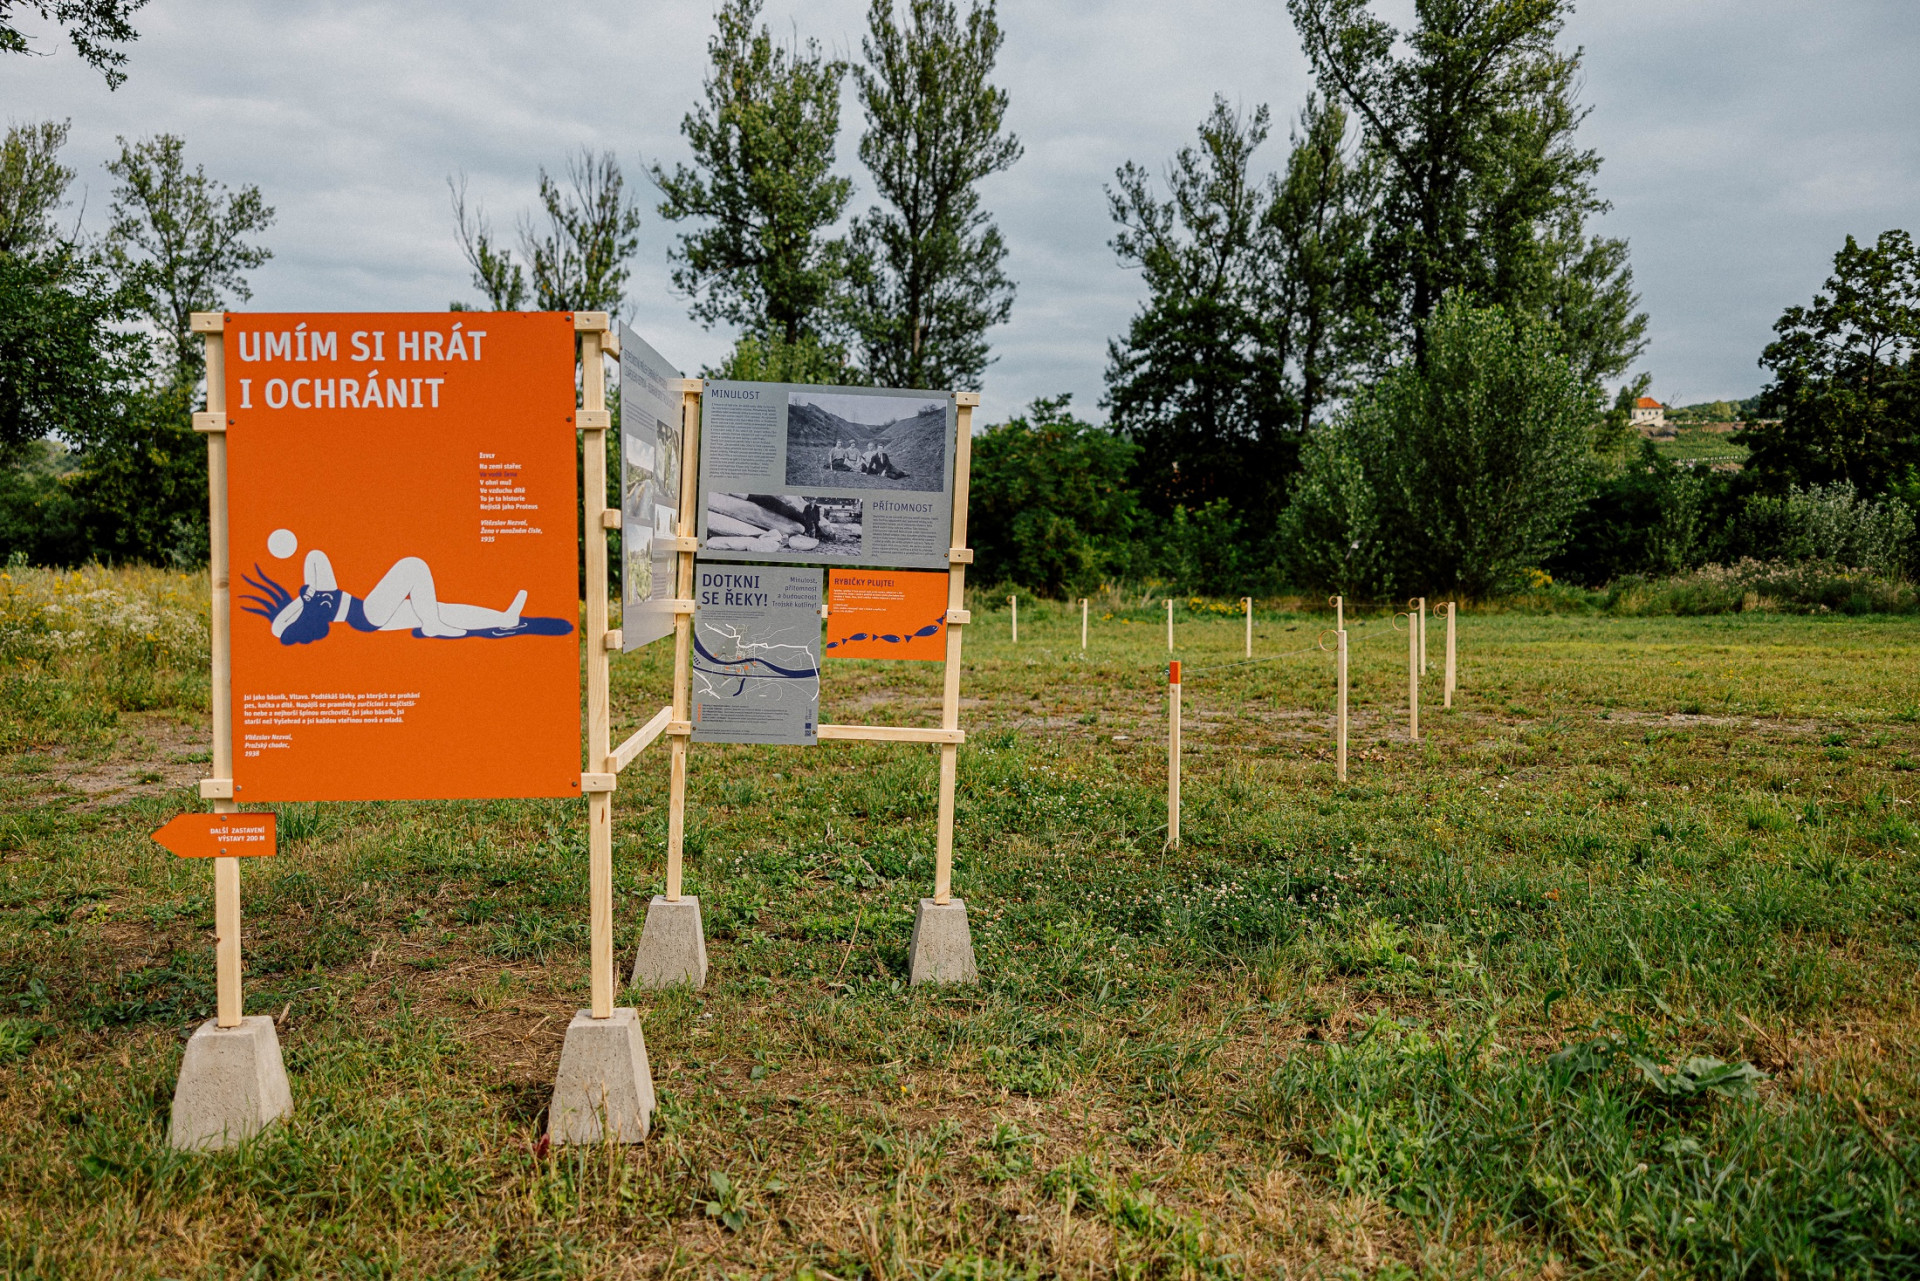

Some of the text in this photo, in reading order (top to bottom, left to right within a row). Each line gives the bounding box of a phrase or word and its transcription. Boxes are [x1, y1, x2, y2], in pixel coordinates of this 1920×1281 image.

[239, 322, 487, 362] UMÍM SI HRÁT
[240, 369, 445, 409] I OCHRÁNIT
[711, 389, 760, 400] MINULOST
[872, 501, 933, 513] PŘÍTOMNOST
[702, 573, 760, 589] DOTKNI
[790, 576, 818, 584] Minulost,
[834, 577, 895, 587] RYBIČKY PLUJTE!
[784, 584, 817, 592] přítomnost
[701, 589, 768, 607] SE ŘEKY!
[772, 600, 793, 608] Trojské
[210, 826, 265, 834] DALŠÍ ZASTAVENÍ
[217, 834, 245, 842] VÝSTAVY
